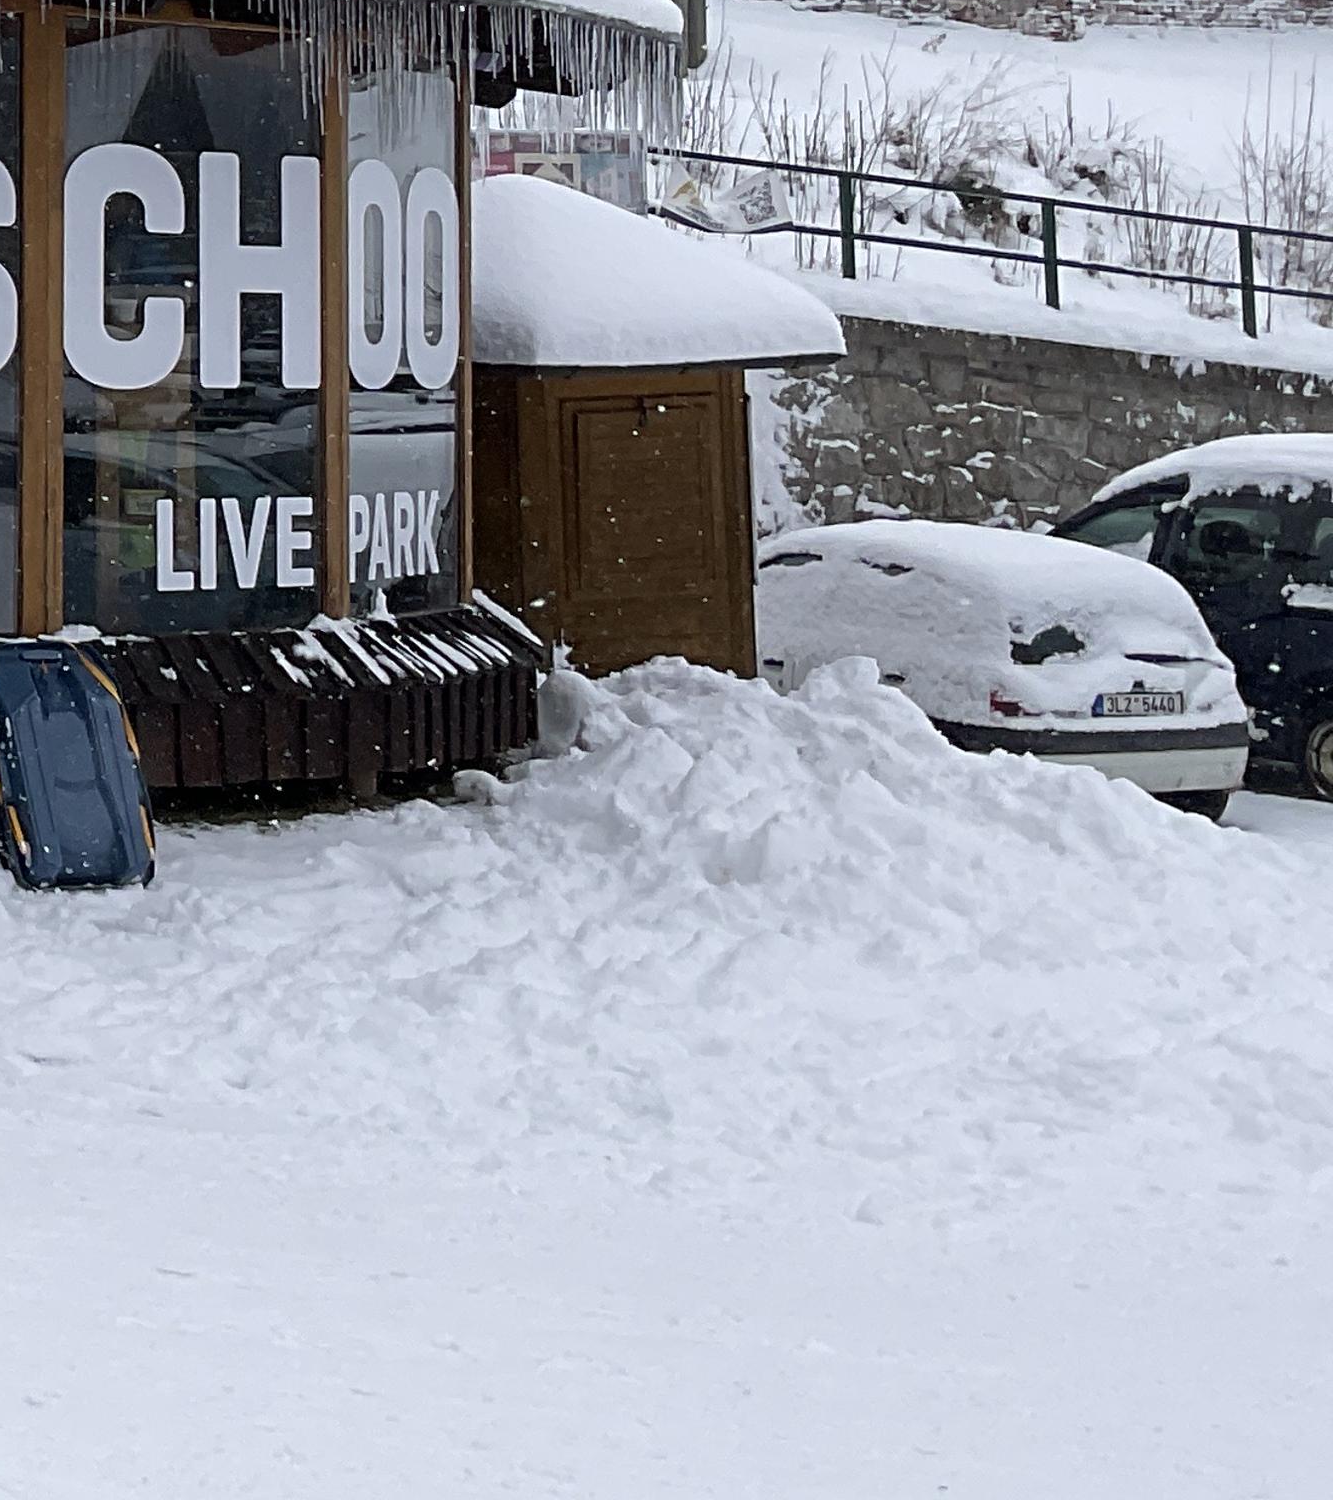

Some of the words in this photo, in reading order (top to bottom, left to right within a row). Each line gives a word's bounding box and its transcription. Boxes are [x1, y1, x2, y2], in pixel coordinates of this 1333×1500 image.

[156, 497, 314, 592] LIVE
[348, 489, 440, 583] PARK
[1142, 696, 1175, 713] 5440
